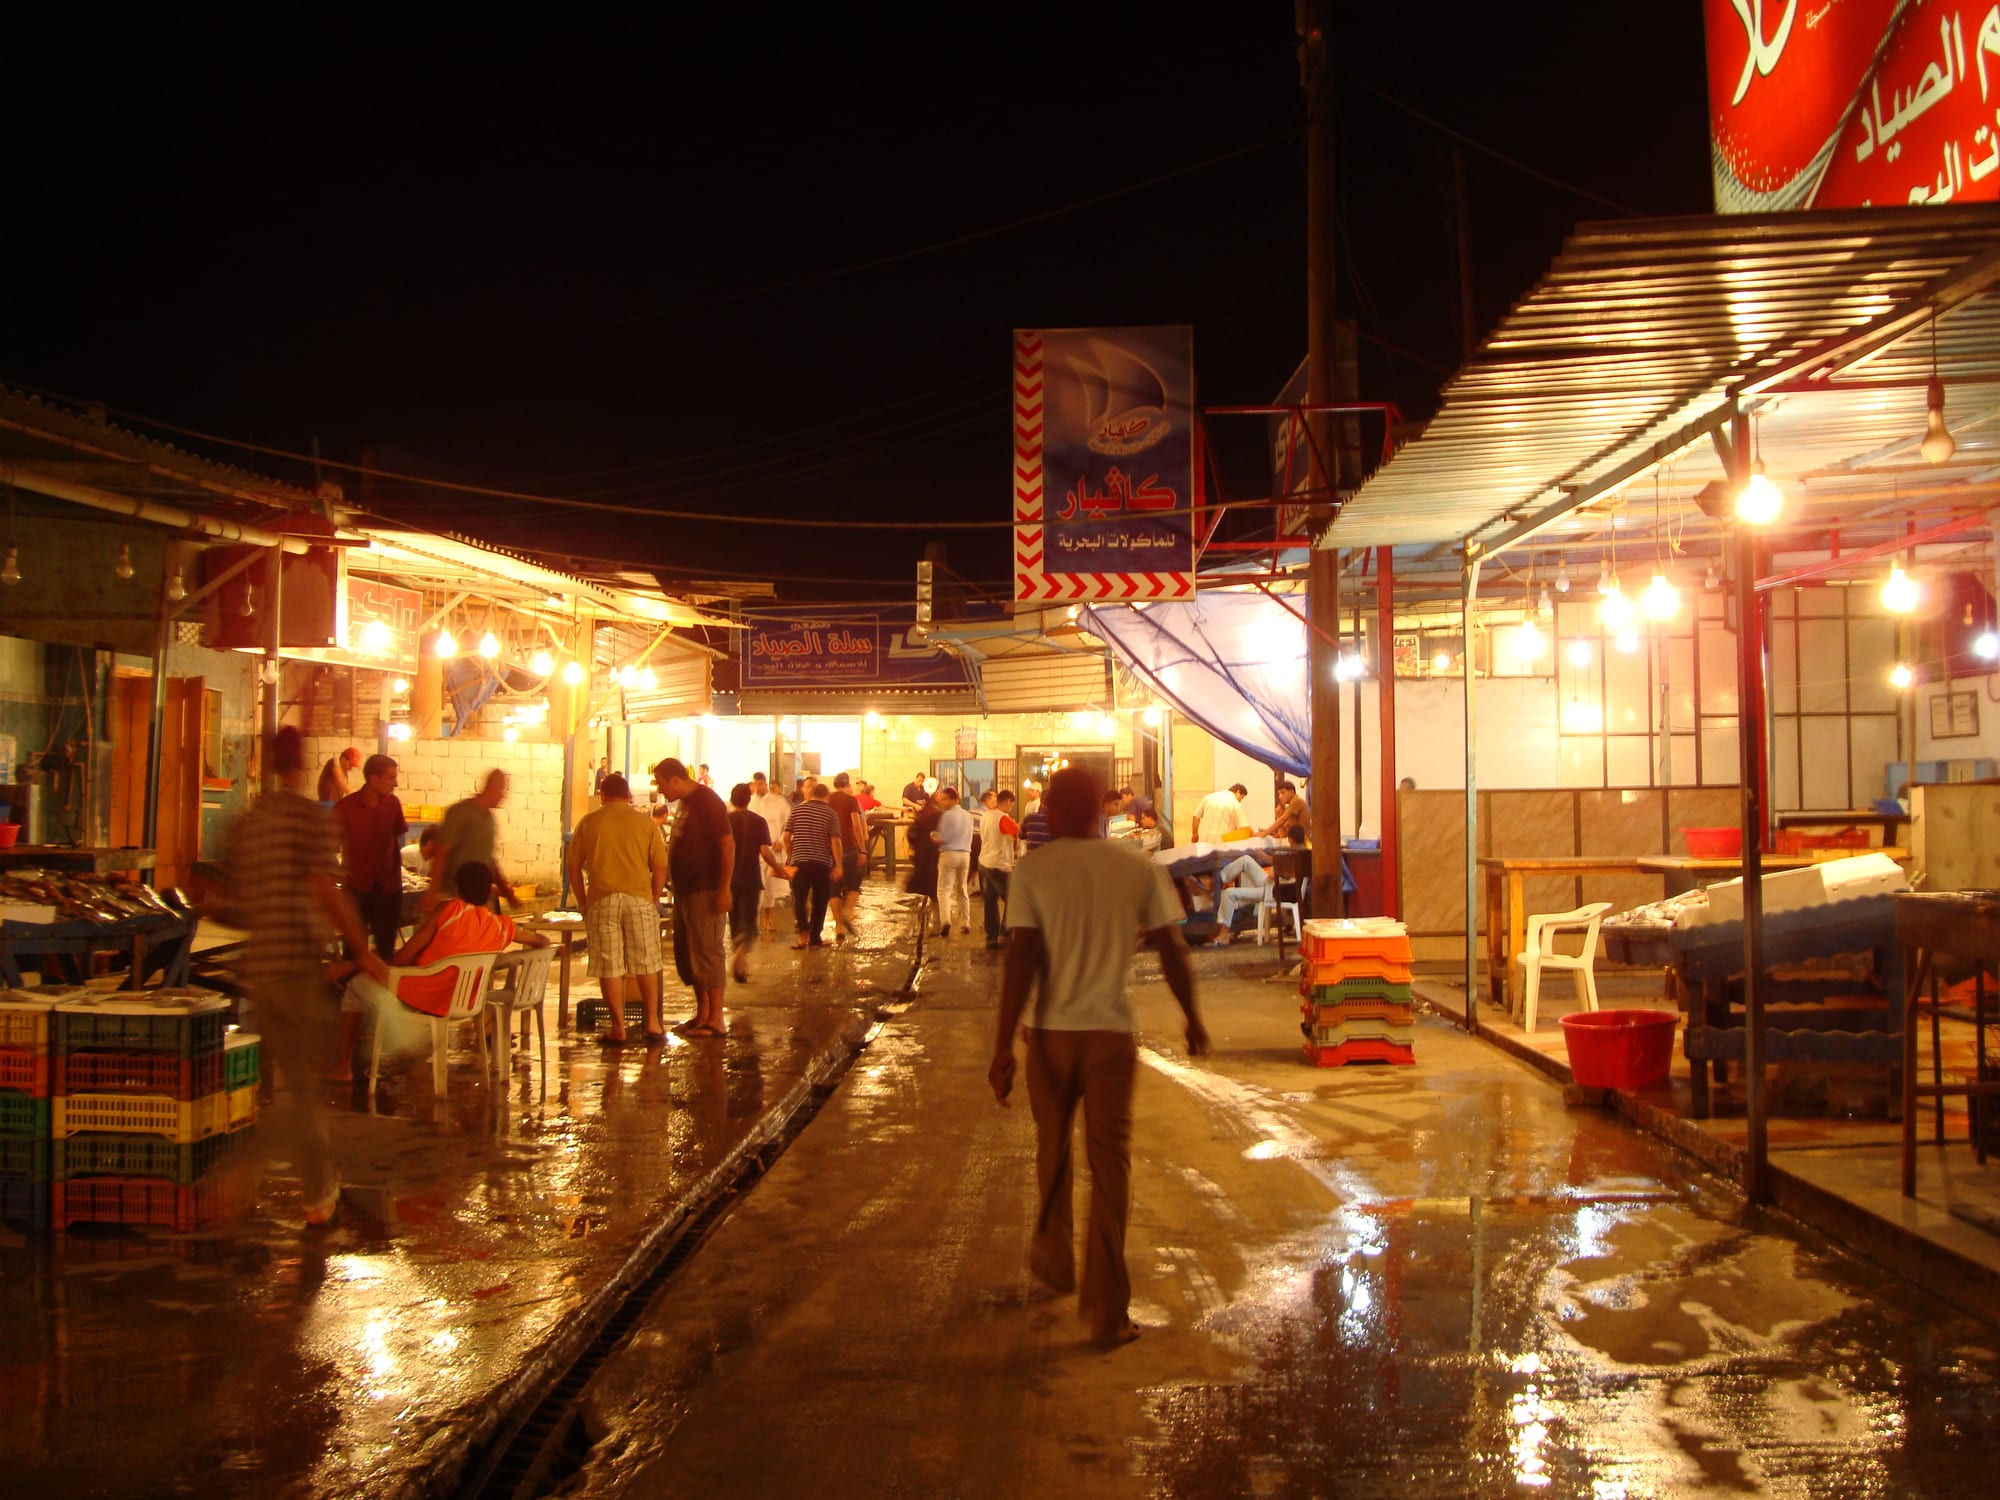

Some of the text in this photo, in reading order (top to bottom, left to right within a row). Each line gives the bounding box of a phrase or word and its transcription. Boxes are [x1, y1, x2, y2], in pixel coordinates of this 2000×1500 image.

[1058, 532, 1105, 553] البحرية
[752, 631, 823, 661] الصياد
[828, 631, 873, 654] سلة
